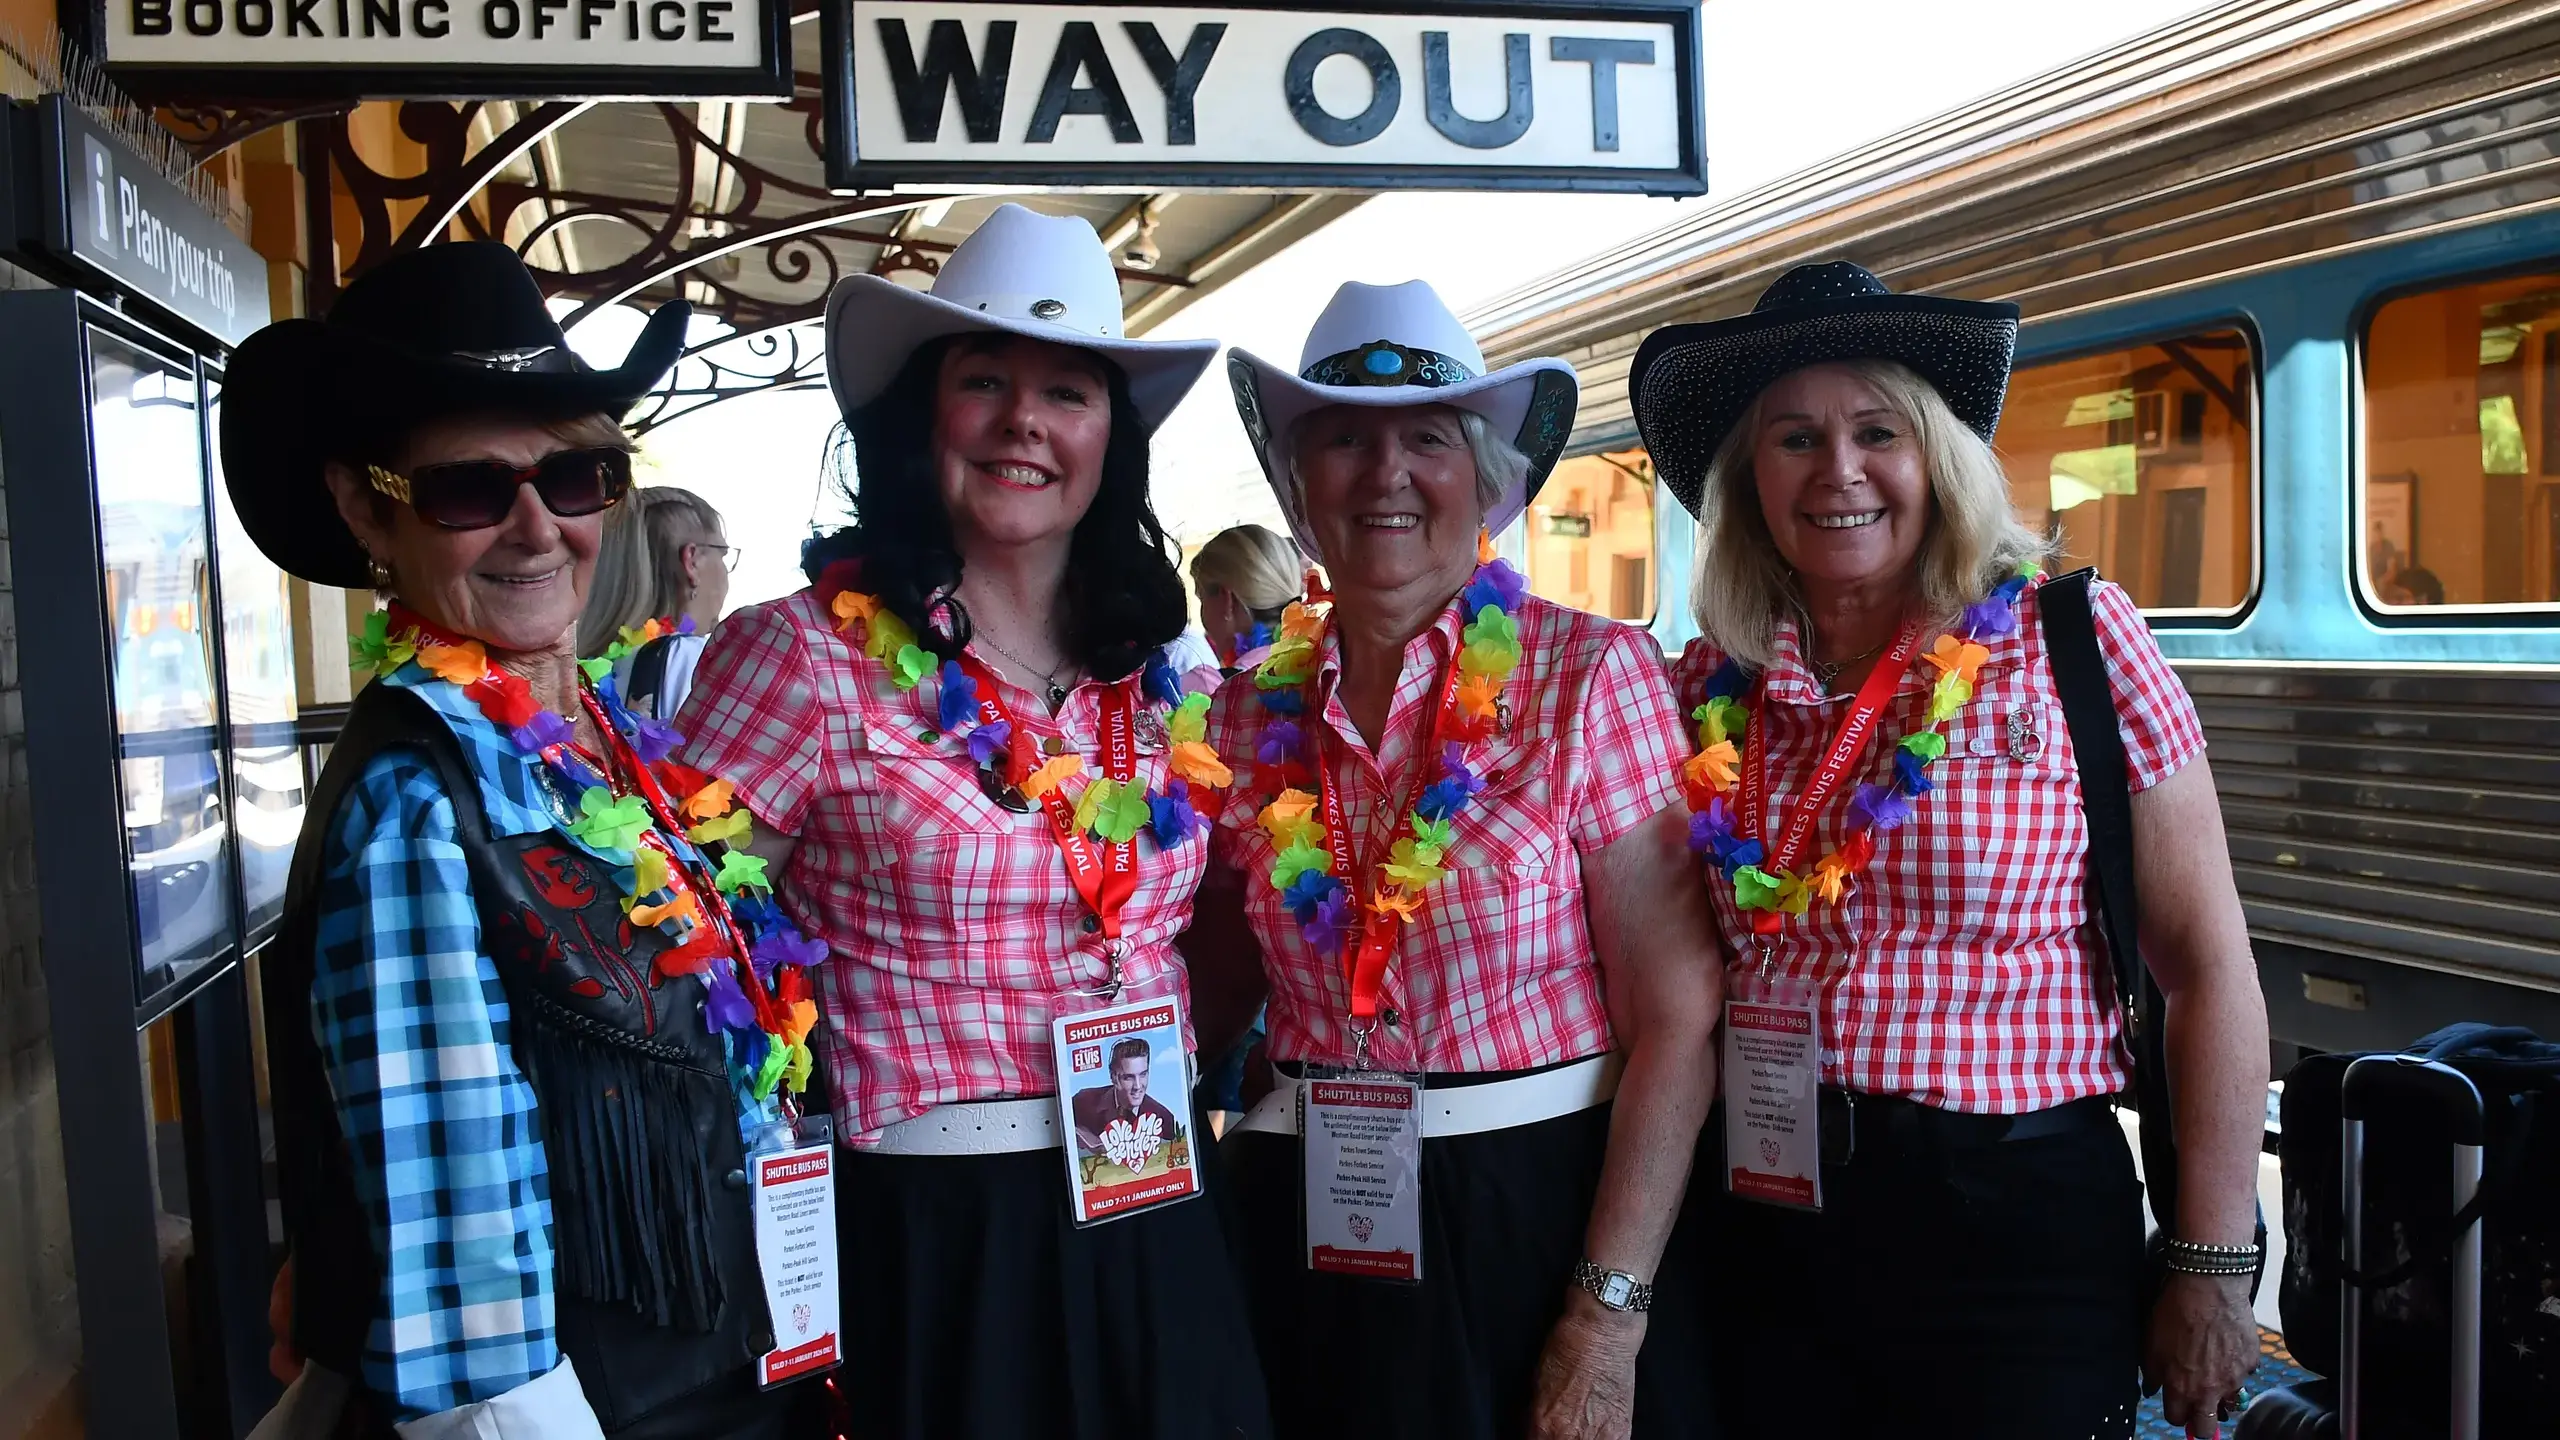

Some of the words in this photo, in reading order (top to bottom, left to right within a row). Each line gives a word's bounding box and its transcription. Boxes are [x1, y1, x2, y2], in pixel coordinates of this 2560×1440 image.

[133, 0, 448, 37] BOOKING
[484, 0, 733, 41] OFFICE
[875, 18, 1228, 146] WAY
[1283, 27, 1655, 153] OUT
[120, 176, 165, 273] Plan
[166, 227, 205, 297] your
[207, 247, 235, 332] trip
[1111, 707, 1127, 769] FESTIVAL
[1746, 762, 1758, 799] ELVIS
[1775, 813, 1809, 875] PARKES
[1803, 771, 1836, 810] ELVIS
[1828, 706, 1874, 771] FESTIVAL
[1333, 830, 1350, 871] ELVIS
[1070, 1022, 1118, 1040] SHUTTLE
[1120, 1018, 1141, 1030] BUS
[1143, 1012, 1169, 1026] PASS
[1734, 1012, 1768, 1024] SHUTTLE
[1770, 1016, 1785, 1025] BUS
[1787, 1018, 1807, 1028] PASS
[1318, 1089, 1360, 1100] SHUTTLE
[1363, 1092, 1382, 1101] BUS
[1384, 1093, 1408, 1103] PASS
[1355, 1146, 1366, 1154] Town
[766, 1164, 797, 1180] SHUTTLE
[798, 1161, 811, 1173] BUS
[812, 1158, 827, 1170] PASS
[1091, 1200, 1114, 1210] VALID
[1115, 1195, 1130, 1205] 7-11
[1132, 1186, 1165, 1201] JANUARY
[1166, 1181, 1185, 1192] ONLY
[1320, 1255, 1337, 1263] VALID
[1351, 1258, 1376, 1266] JANUARY
